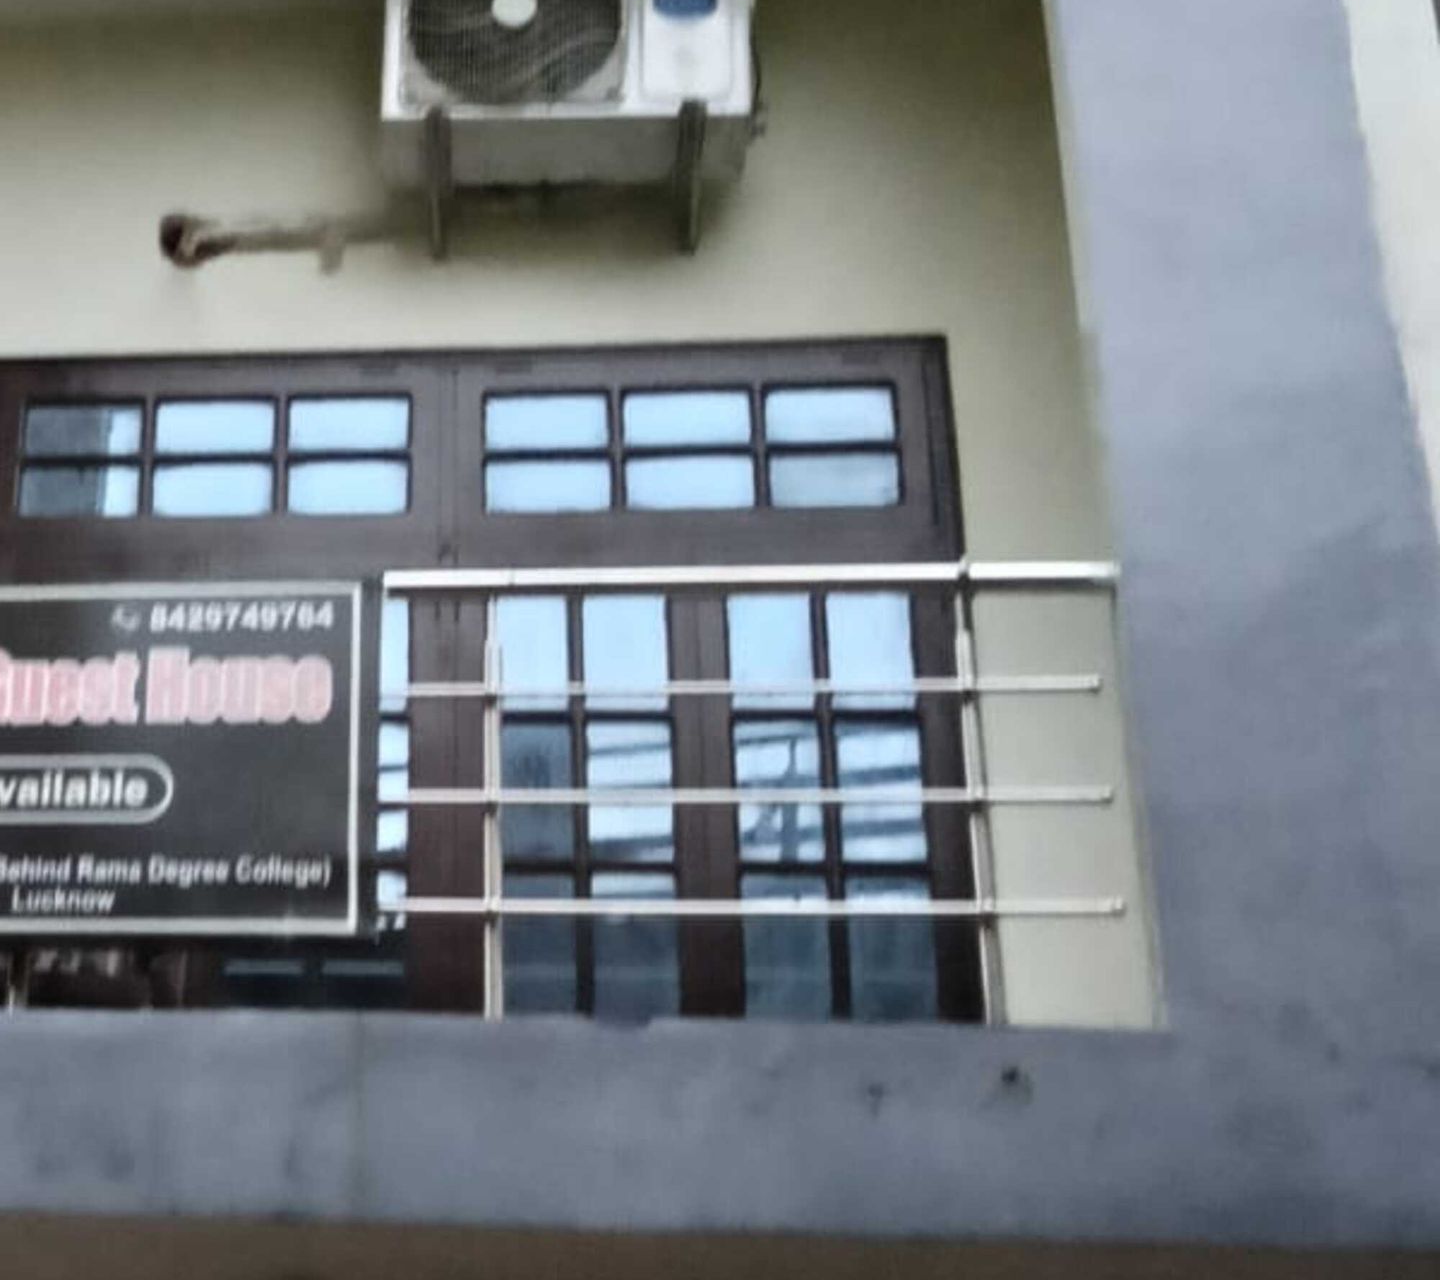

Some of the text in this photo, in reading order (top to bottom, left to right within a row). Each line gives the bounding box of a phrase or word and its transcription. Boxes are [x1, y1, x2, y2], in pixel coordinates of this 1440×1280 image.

[144, 647, 334, 726] House
[77, 855, 142, 884] Rama
[147, 855, 229, 887] Degree
[234, 854, 332, 887] College)
[11, 883, 116, 913] Lucknow
